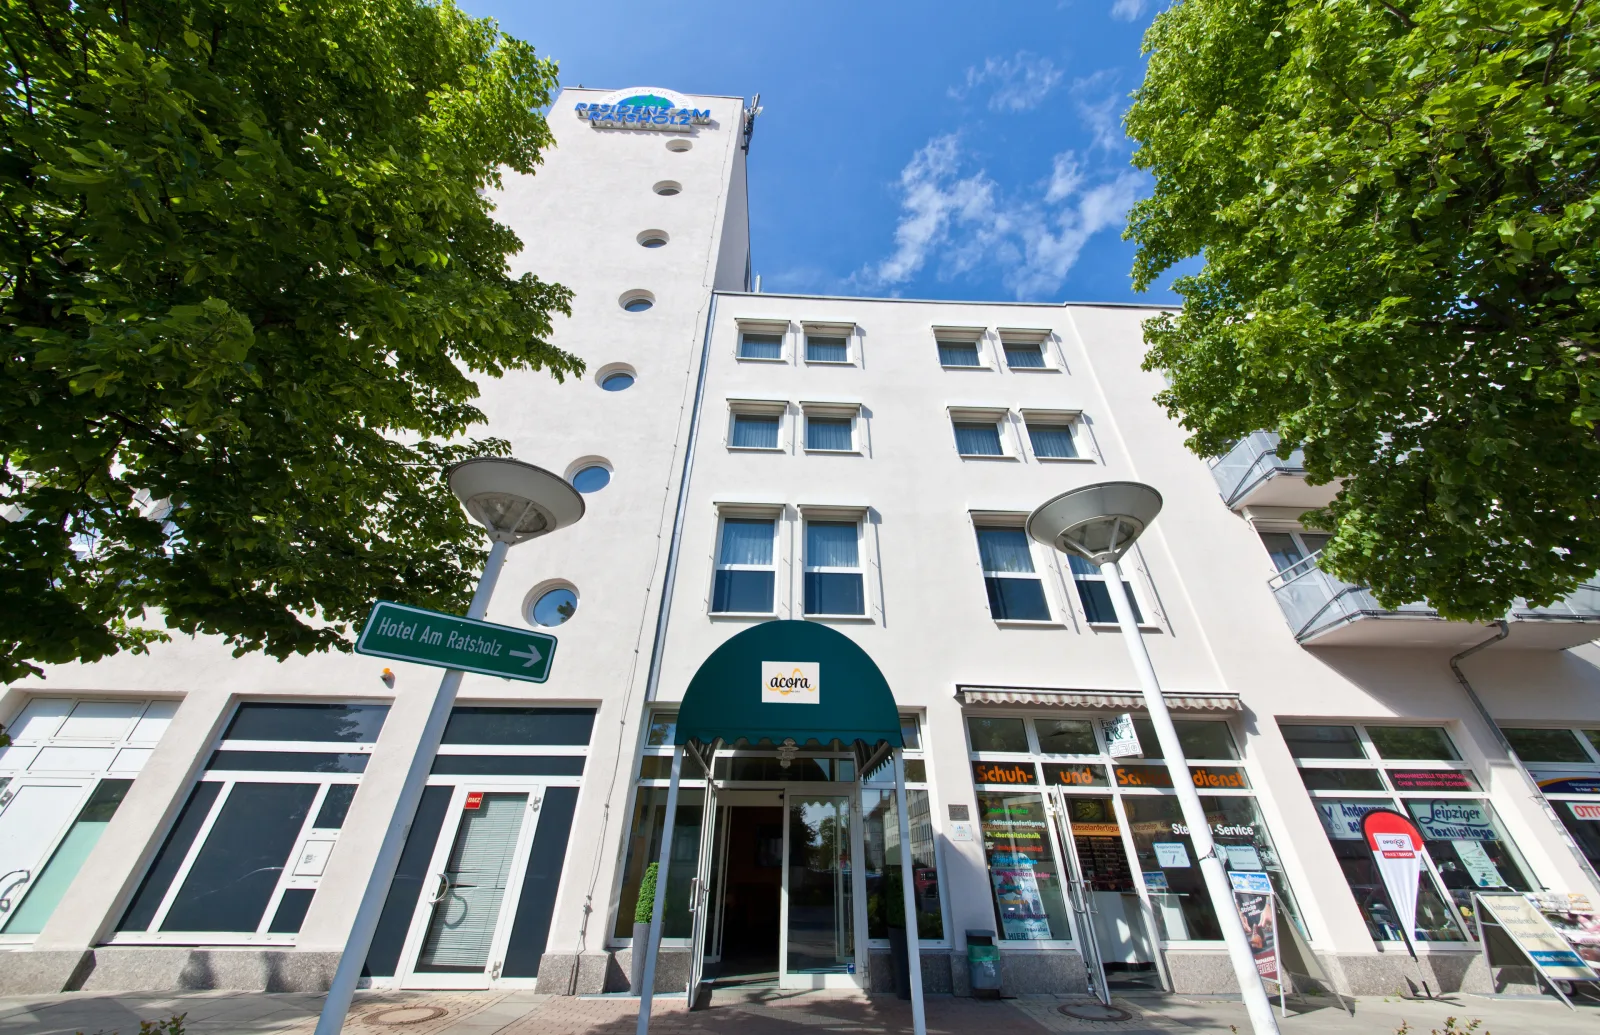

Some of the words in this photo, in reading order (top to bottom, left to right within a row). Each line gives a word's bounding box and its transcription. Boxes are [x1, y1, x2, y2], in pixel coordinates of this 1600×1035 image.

[575, 102, 671, 115] RESIDENZ
[676, 108, 711, 117] AM
[588, 111, 691, 125] RATSHOLZ
[377, 616, 417, 641] Hotel
[418, 625, 443, 646] Am
[446, 631, 503, 657] Ratsholz
[770, 677, 811, 689] acora
[977, 766, 1033, 783] Schuh-
[1059, 768, 1093, 784] und
[1419, 799, 1482, 824] Leipziger
[1426, 826, 1495, 840] Textilpflege
